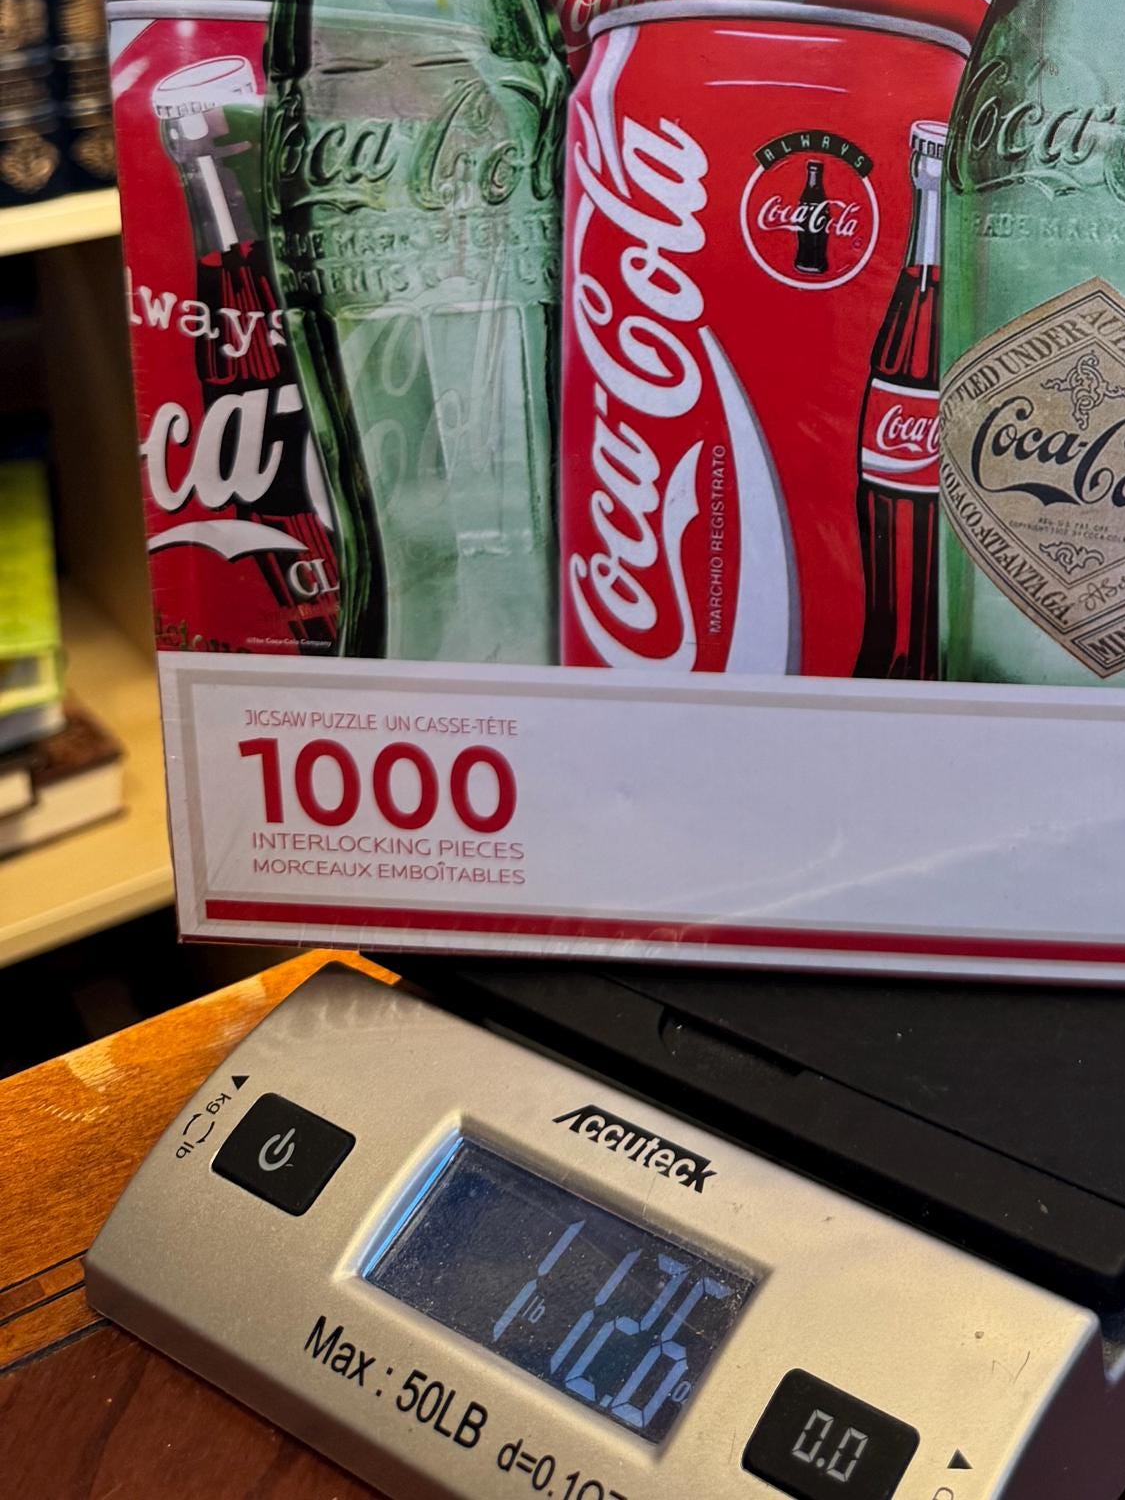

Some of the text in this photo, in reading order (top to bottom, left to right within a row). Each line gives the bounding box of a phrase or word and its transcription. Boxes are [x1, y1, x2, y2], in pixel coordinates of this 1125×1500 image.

[764, 134, 866, 169] ALWAYS
[757, 195, 861, 237] Coca-Cola
[126, 265, 287, 358] lways
[1002, 316, 1098, 375] UNDER
[569, 98, 710, 673] Coca-Cola
[707, 443, 728, 635] MARCHIO REGISTRATO
[244, 709, 519, 737] JIGSAW PUZZLE UN CASSE-TÊTE
[238, 736, 518, 834] 1000
[251, 831, 525, 861] INTERLOCKING PIECES
[252, 858, 526, 886] MORCEAUX EMBOÎTABLES
[551, 1103, 718, 1194] Accuteck
[549, 1248, 733, 1429] 12.6
[304, 1314, 376, 1388] Max
[395, 1368, 489, 1449] 50LB
[792, 1408, 868, 1483] 0.0
